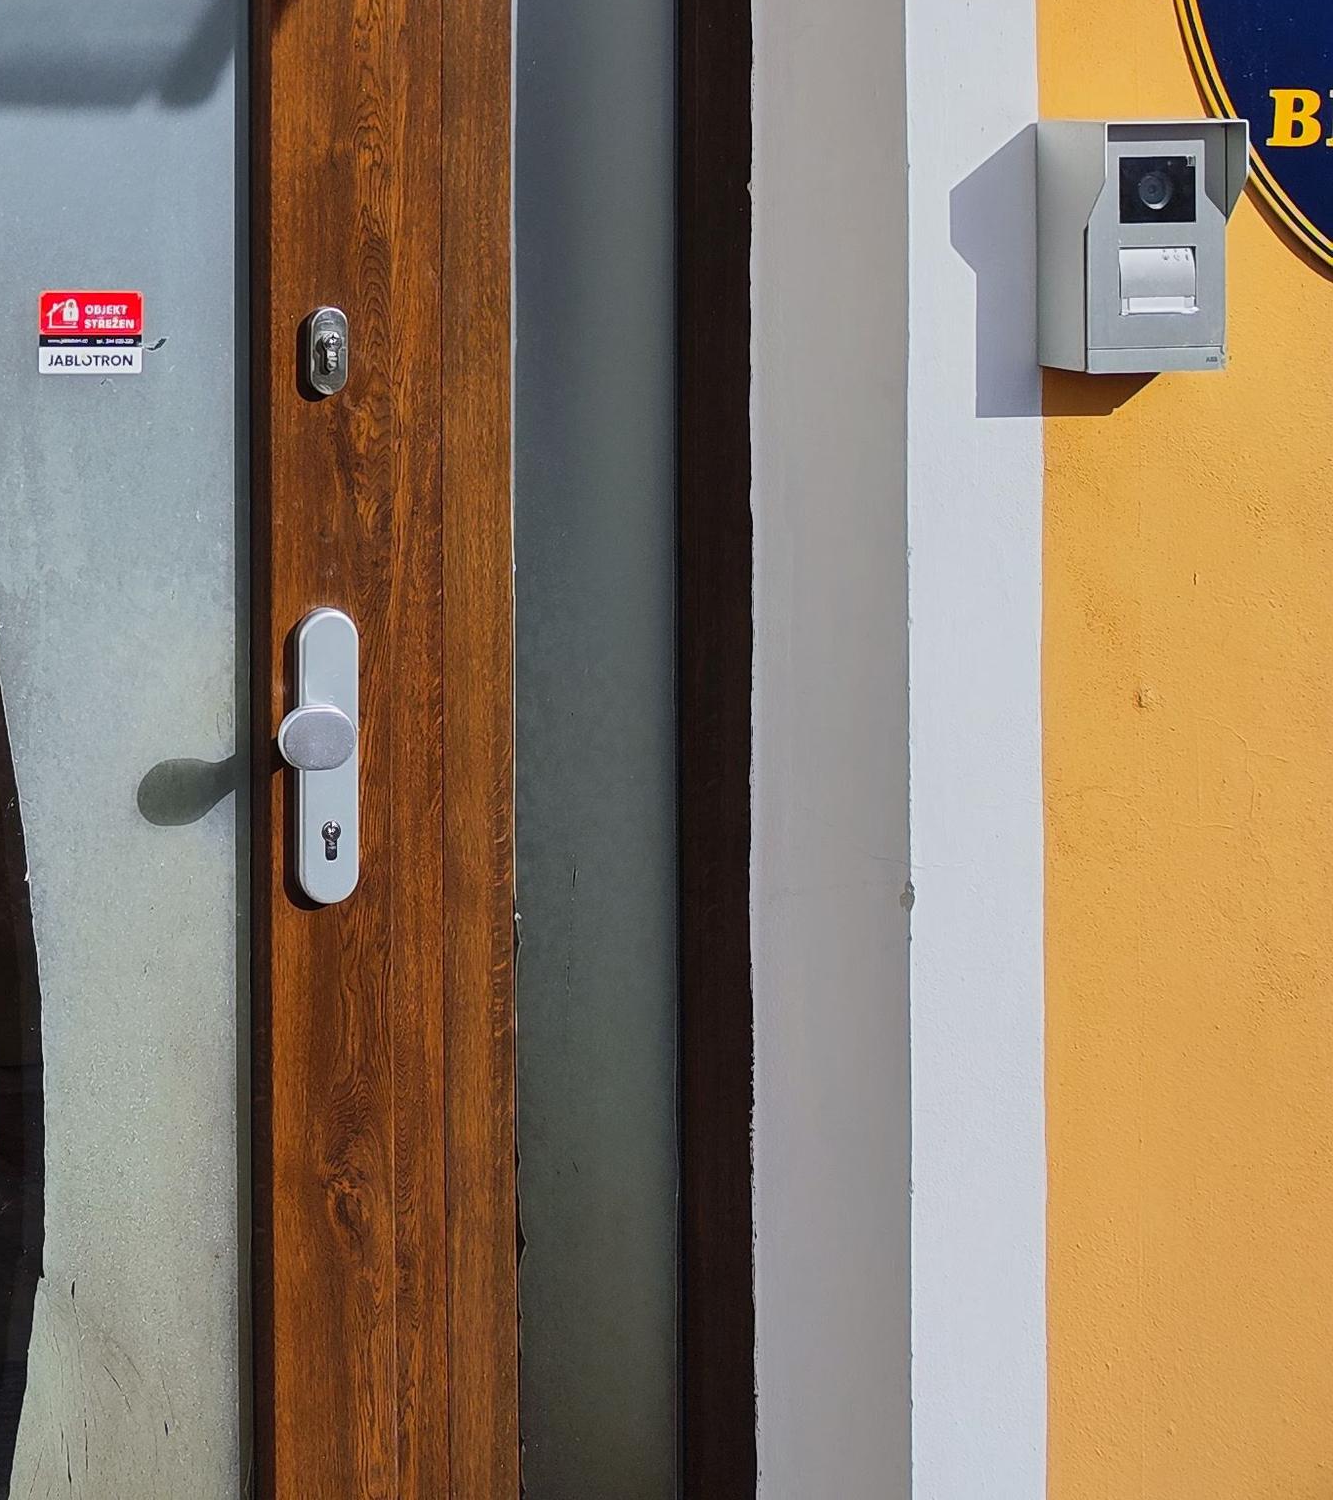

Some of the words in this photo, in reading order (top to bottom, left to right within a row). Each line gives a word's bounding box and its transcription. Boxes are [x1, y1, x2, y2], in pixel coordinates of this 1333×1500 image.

[1266, 88, 1333, 147] B
[84, 304, 128, 315] OBJEKT
[84, 316, 135, 329] STŘEŽEN
[47, 355, 133, 367] JABLOTRON
